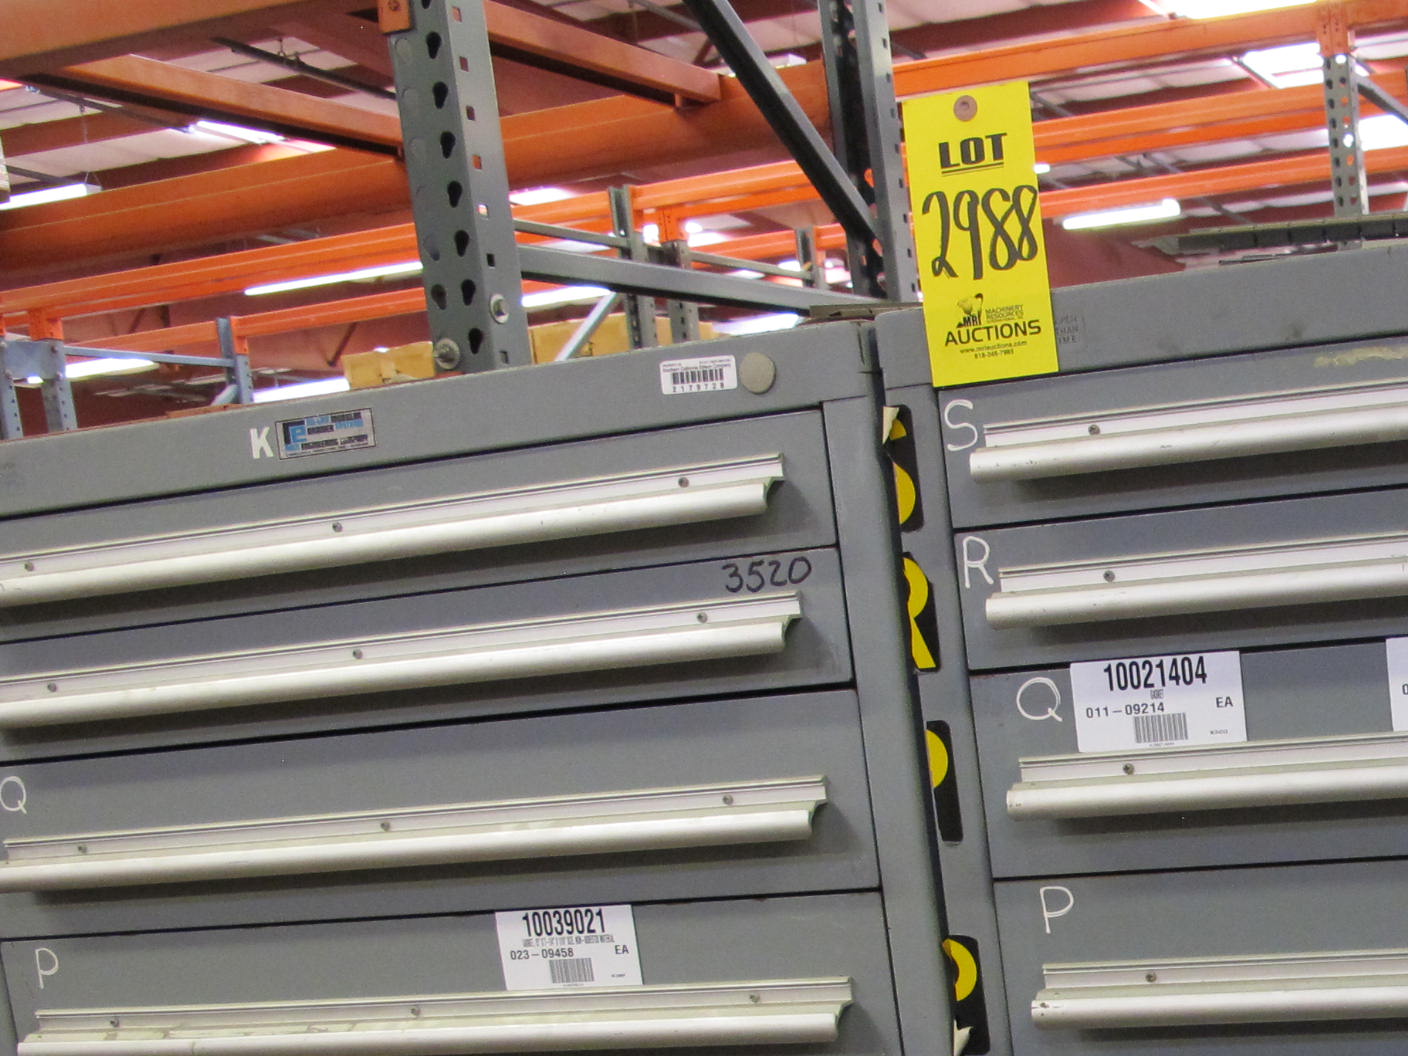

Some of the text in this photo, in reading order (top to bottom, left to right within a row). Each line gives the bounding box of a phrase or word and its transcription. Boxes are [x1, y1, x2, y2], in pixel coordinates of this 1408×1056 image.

[939, 132, 1007, 169] LOT
[922, 184, 1039, 281] 2988
[944, 319, 1041, 347] AUCTIONS
[249, 426, 274, 459] K
[944, 399, 978, 451] S
[721, 556, 812, 593] 3520
[962, 535, 995, 589] R
[1103, 656, 1207, 691] 10021404
[1016, 677, 1066, 723] Q
[1216, 696, 1234, 708] EA
[0, 775, 27, 814] Q
[522, 908, 605, 937] 10039021
[1039, 886, 1074, 934] P
[34, 947, 59, 989] P
[614, 945, 629, 955] EA
